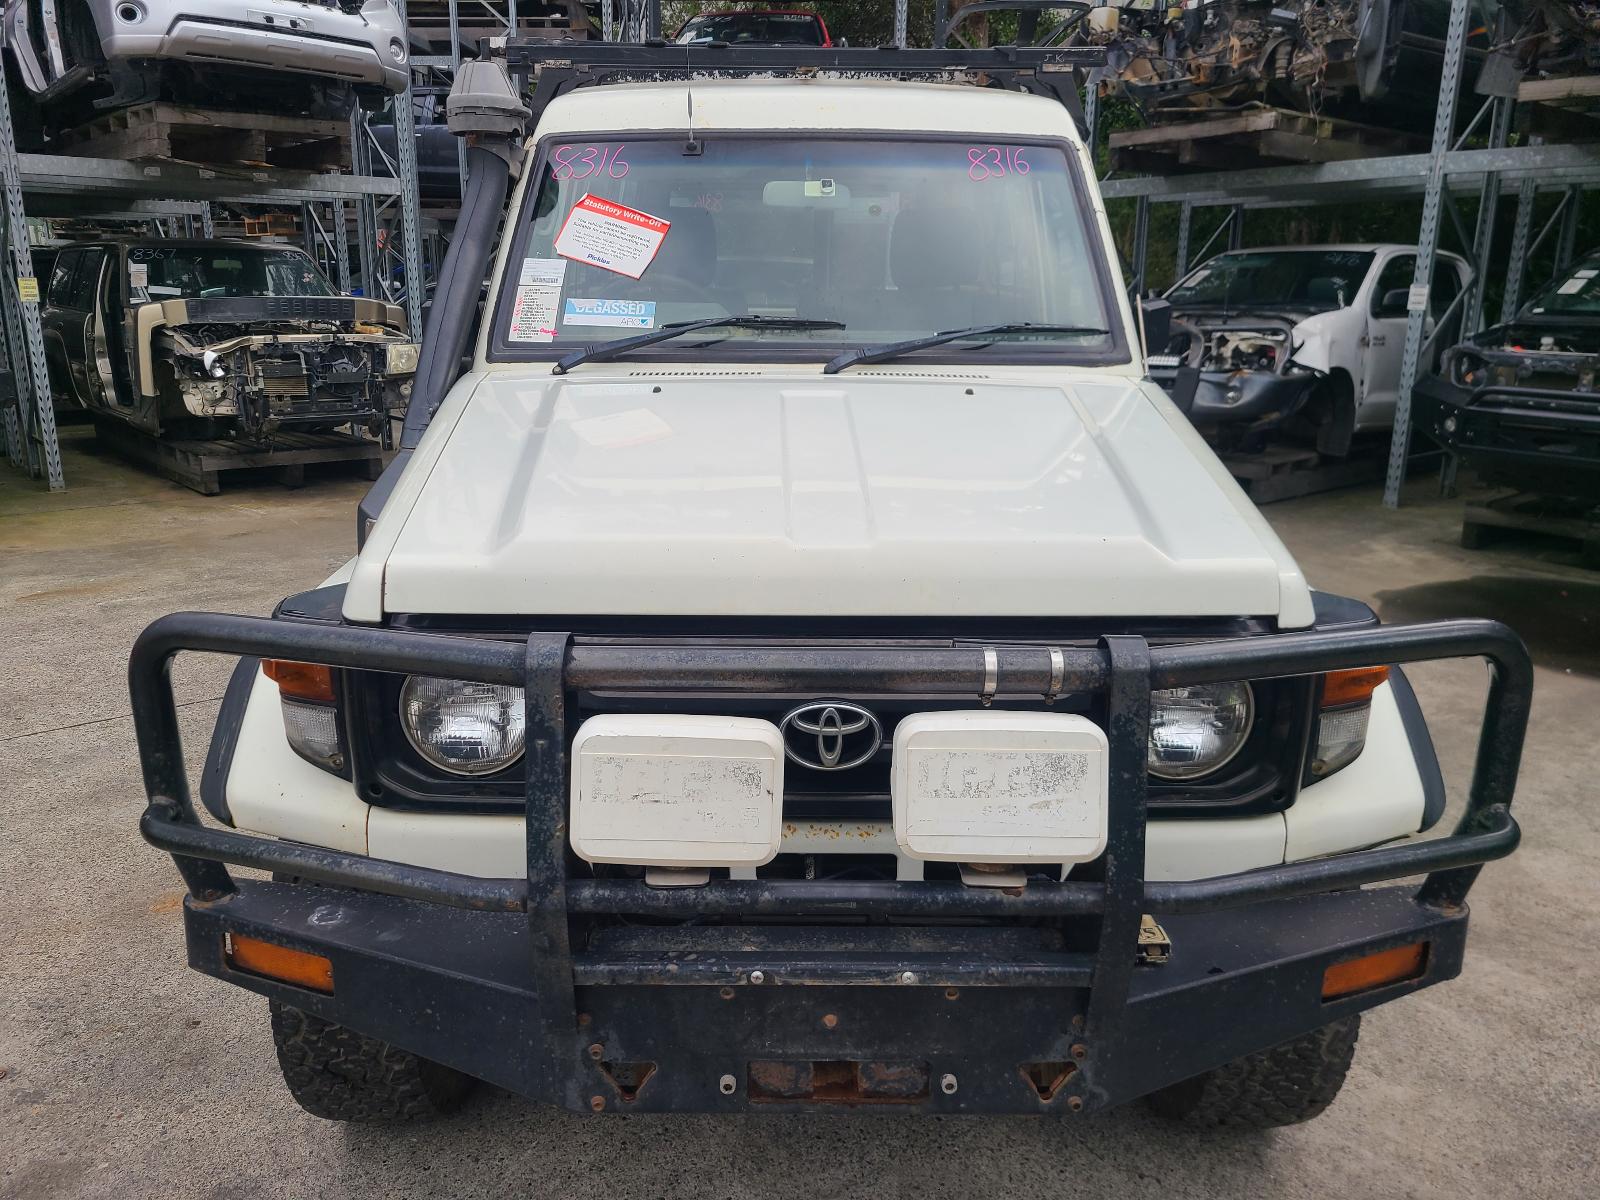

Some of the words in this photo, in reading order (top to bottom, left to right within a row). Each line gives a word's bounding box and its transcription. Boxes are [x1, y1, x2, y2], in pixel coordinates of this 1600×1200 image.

[551, 144, 630, 182] 8316
[967, 147, 1031, 183] 8316
[583, 199, 621, 216] Statutory
[623, 210, 662, 227] Write-Off
[133, 248, 177, 260] 8367
[587, 253, 611, 265] Pickles
